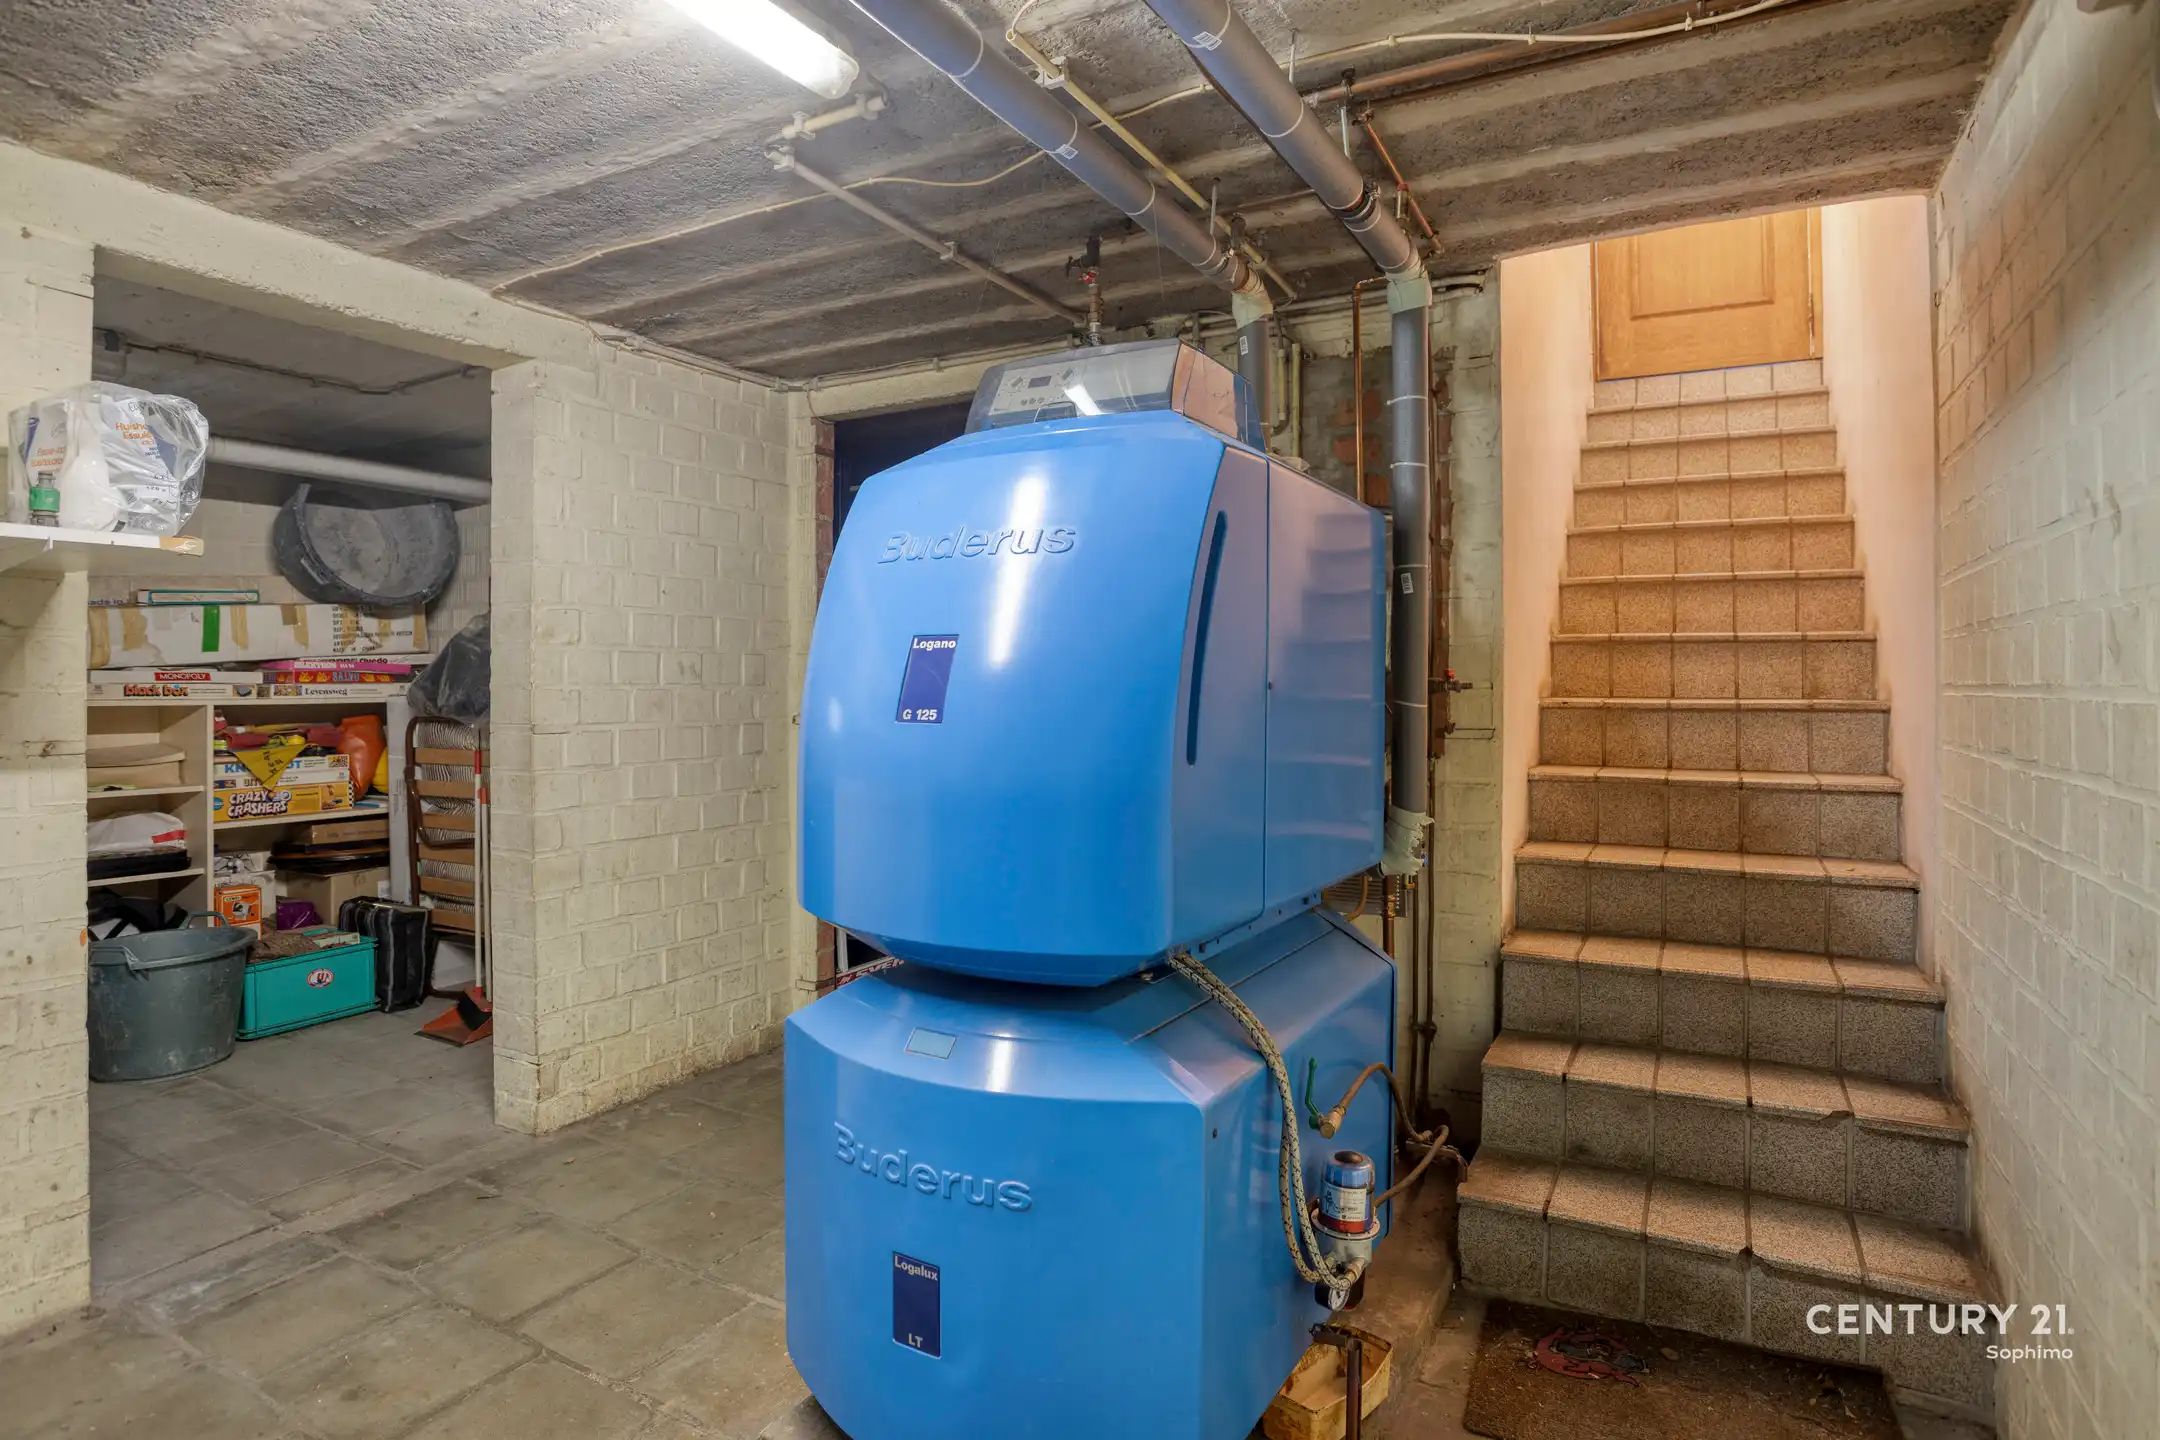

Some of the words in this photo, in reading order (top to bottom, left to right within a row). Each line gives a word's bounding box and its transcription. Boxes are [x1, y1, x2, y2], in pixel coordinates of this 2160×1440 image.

[877, 525, 1076, 564] Buderus
[913, 638, 957, 652] Logano
[159, 672, 207, 680] MONOPOLY
[124, 684, 162, 697] black
[162, 684, 189, 697] box
[305, 687, 348, 696] Levensweg
[902, 709, 912, 720] G
[916, 709, 938, 720] 125
[229, 790, 268, 805] CRAZY
[227, 800, 289, 819] CRASHERS
[834, 1121, 1033, 1213] Buderus
[894, 1255, 938, 1281] Logalux
[908, 1333, 923, 1348] LT
